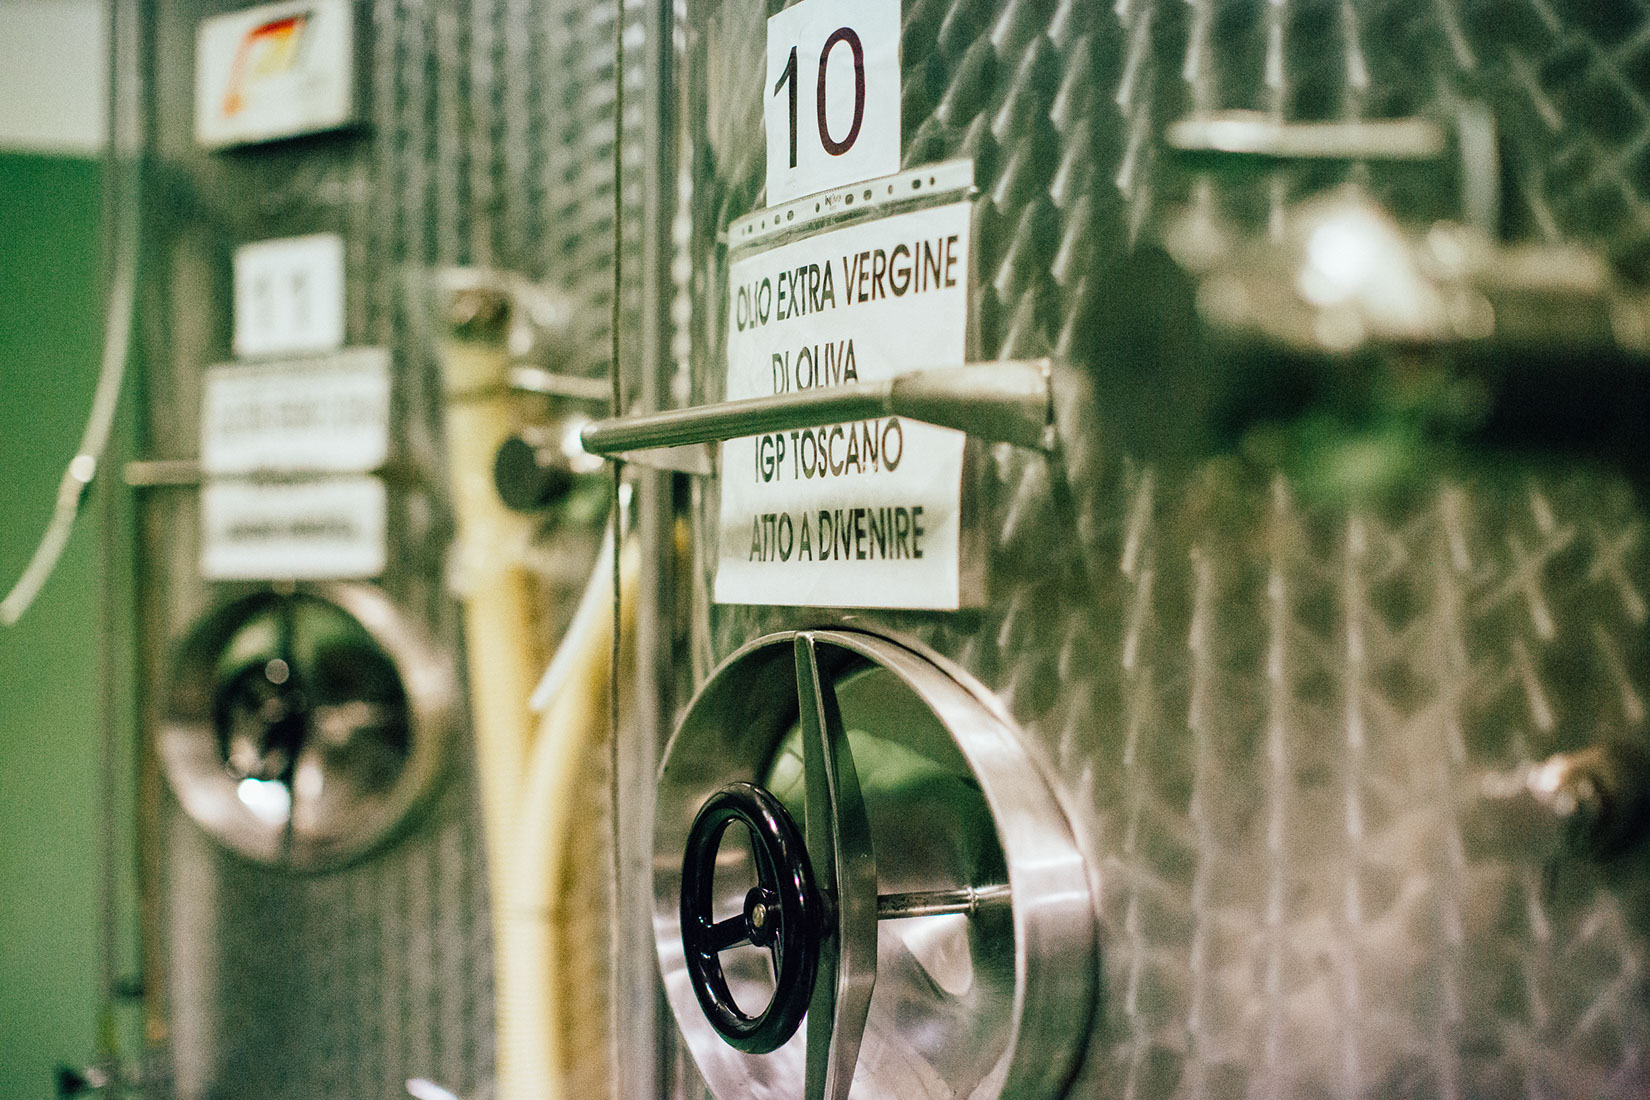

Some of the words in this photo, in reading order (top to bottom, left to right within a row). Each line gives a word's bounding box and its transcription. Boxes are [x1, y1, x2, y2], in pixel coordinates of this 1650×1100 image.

[774, 26, 866, 170] 10
[736, 277, 772, 332] OLIO
[776, 260, 836, 322] EXTRA
[843, 235, 959, 306] VERGINE
[772, 351, 789, 395] DI
[796, 339, 859, 392] OLIVA
[755, 433, 786, 483] IGP
[790, 417, 903, 480] TOSCANO
[749, 512, 794, 562] ATTO
[798, 512, 812, 561] A
[819, 506, 924, 561] DIVENIRE
